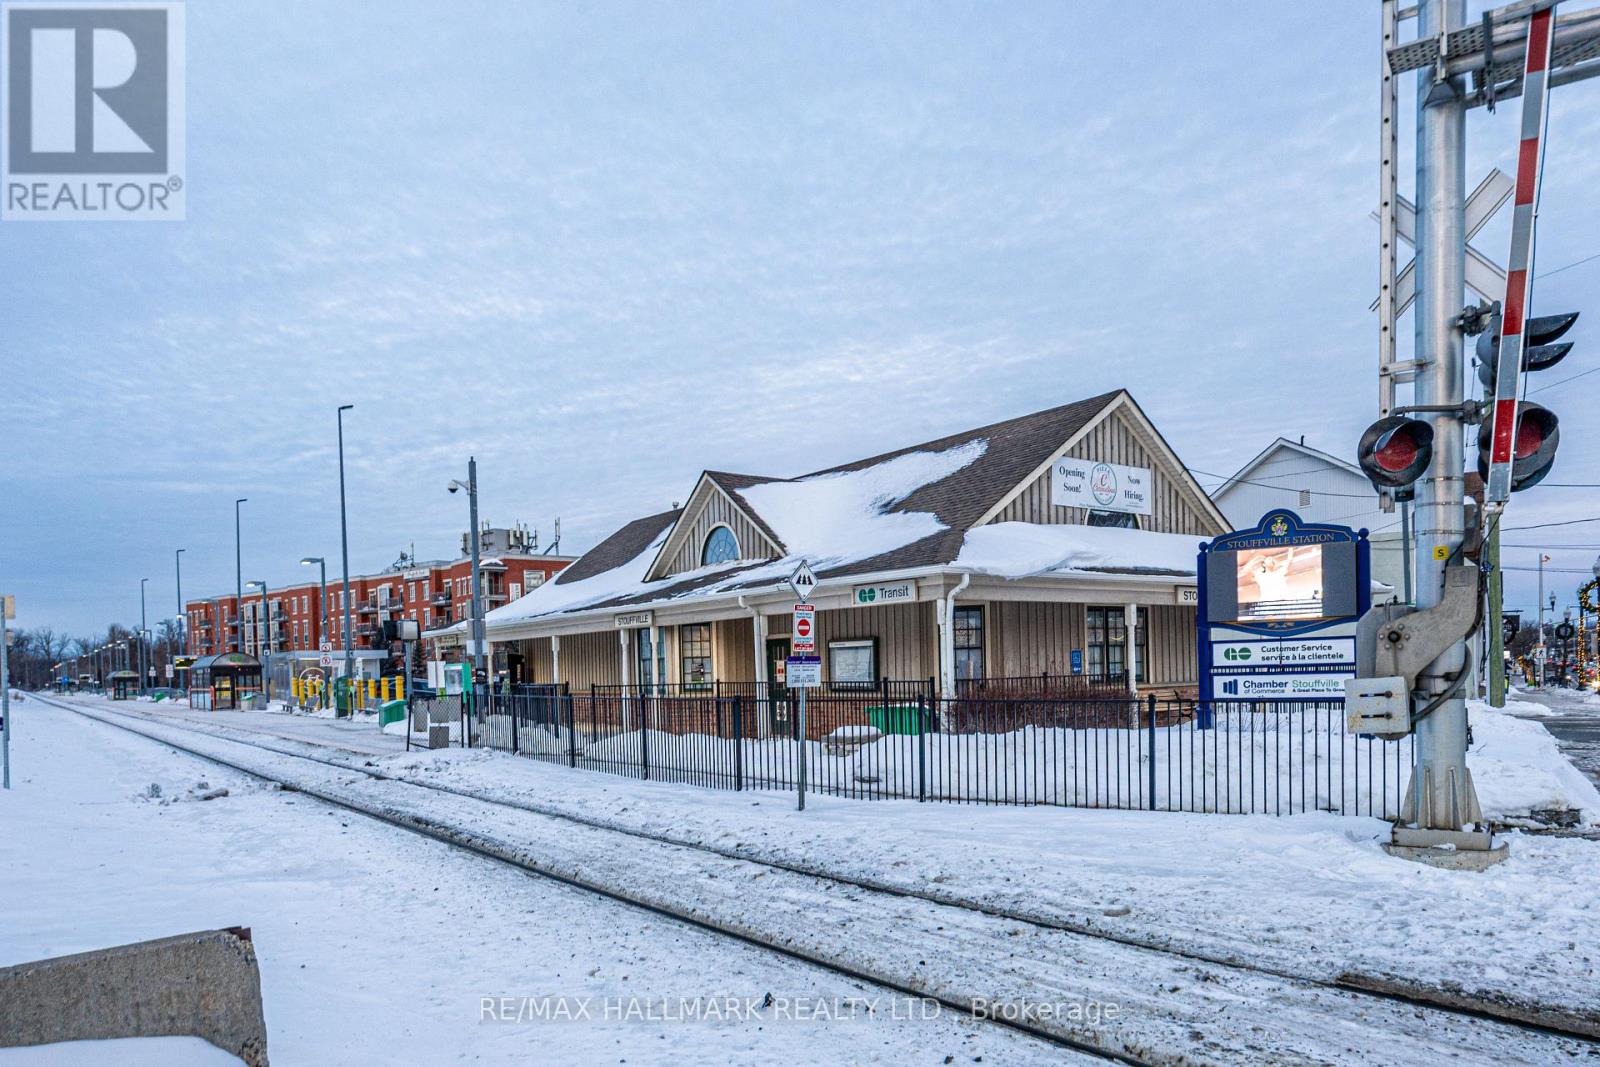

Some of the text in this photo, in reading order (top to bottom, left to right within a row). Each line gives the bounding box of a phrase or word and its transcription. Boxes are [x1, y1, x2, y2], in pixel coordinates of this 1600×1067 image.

[1059, 466, 1086, 479] Opening
[1128, 476, 1140, 484] Now
[1064, 483, 1082, 492] Soon!
[1228, 533, 1335, 548] STOUFFVILLE STATION
[1438, 549, 1444, 557] S
[858, 586, 908, 602] GO Transit
[618, 615, 648, 625] STOUFFVILLE
[1224, 647, 1252, 660] GO
[1261, 644, 1332, 653] Customer Service
[1261, 653, 1290, 661] service
[1243, 679, 1340, 689] Chamber Stouffville
